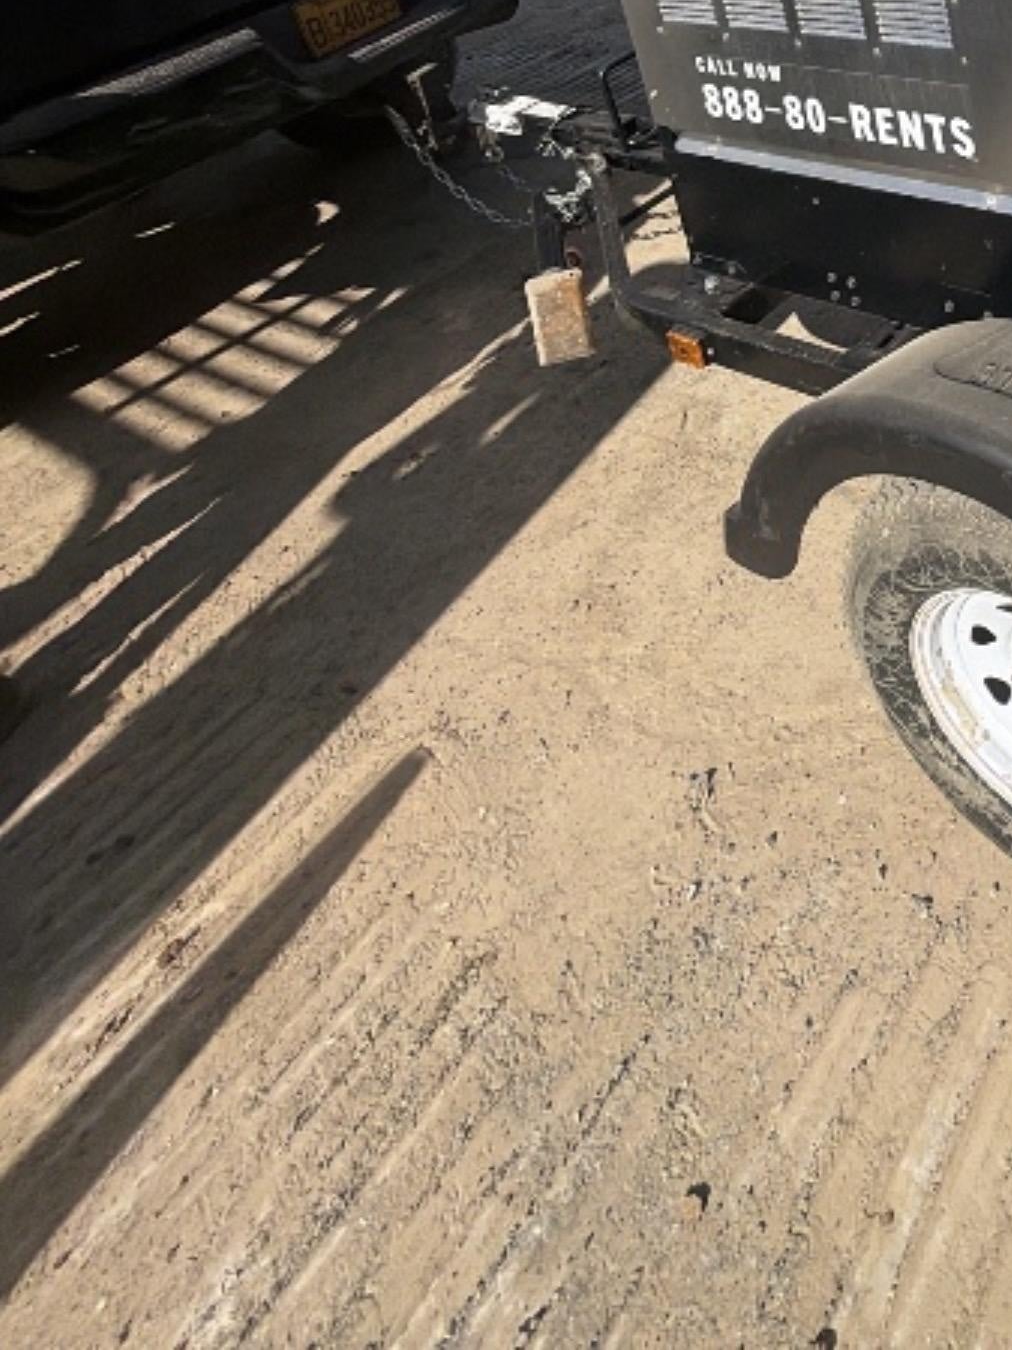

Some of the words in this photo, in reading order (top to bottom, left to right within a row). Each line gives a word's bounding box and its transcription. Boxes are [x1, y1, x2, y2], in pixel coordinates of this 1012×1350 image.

[695, 56, 738, 76] CALL
[743, 62, 781, 82] NOW
[701, 83, 977, 160] 888-80-RENTS
